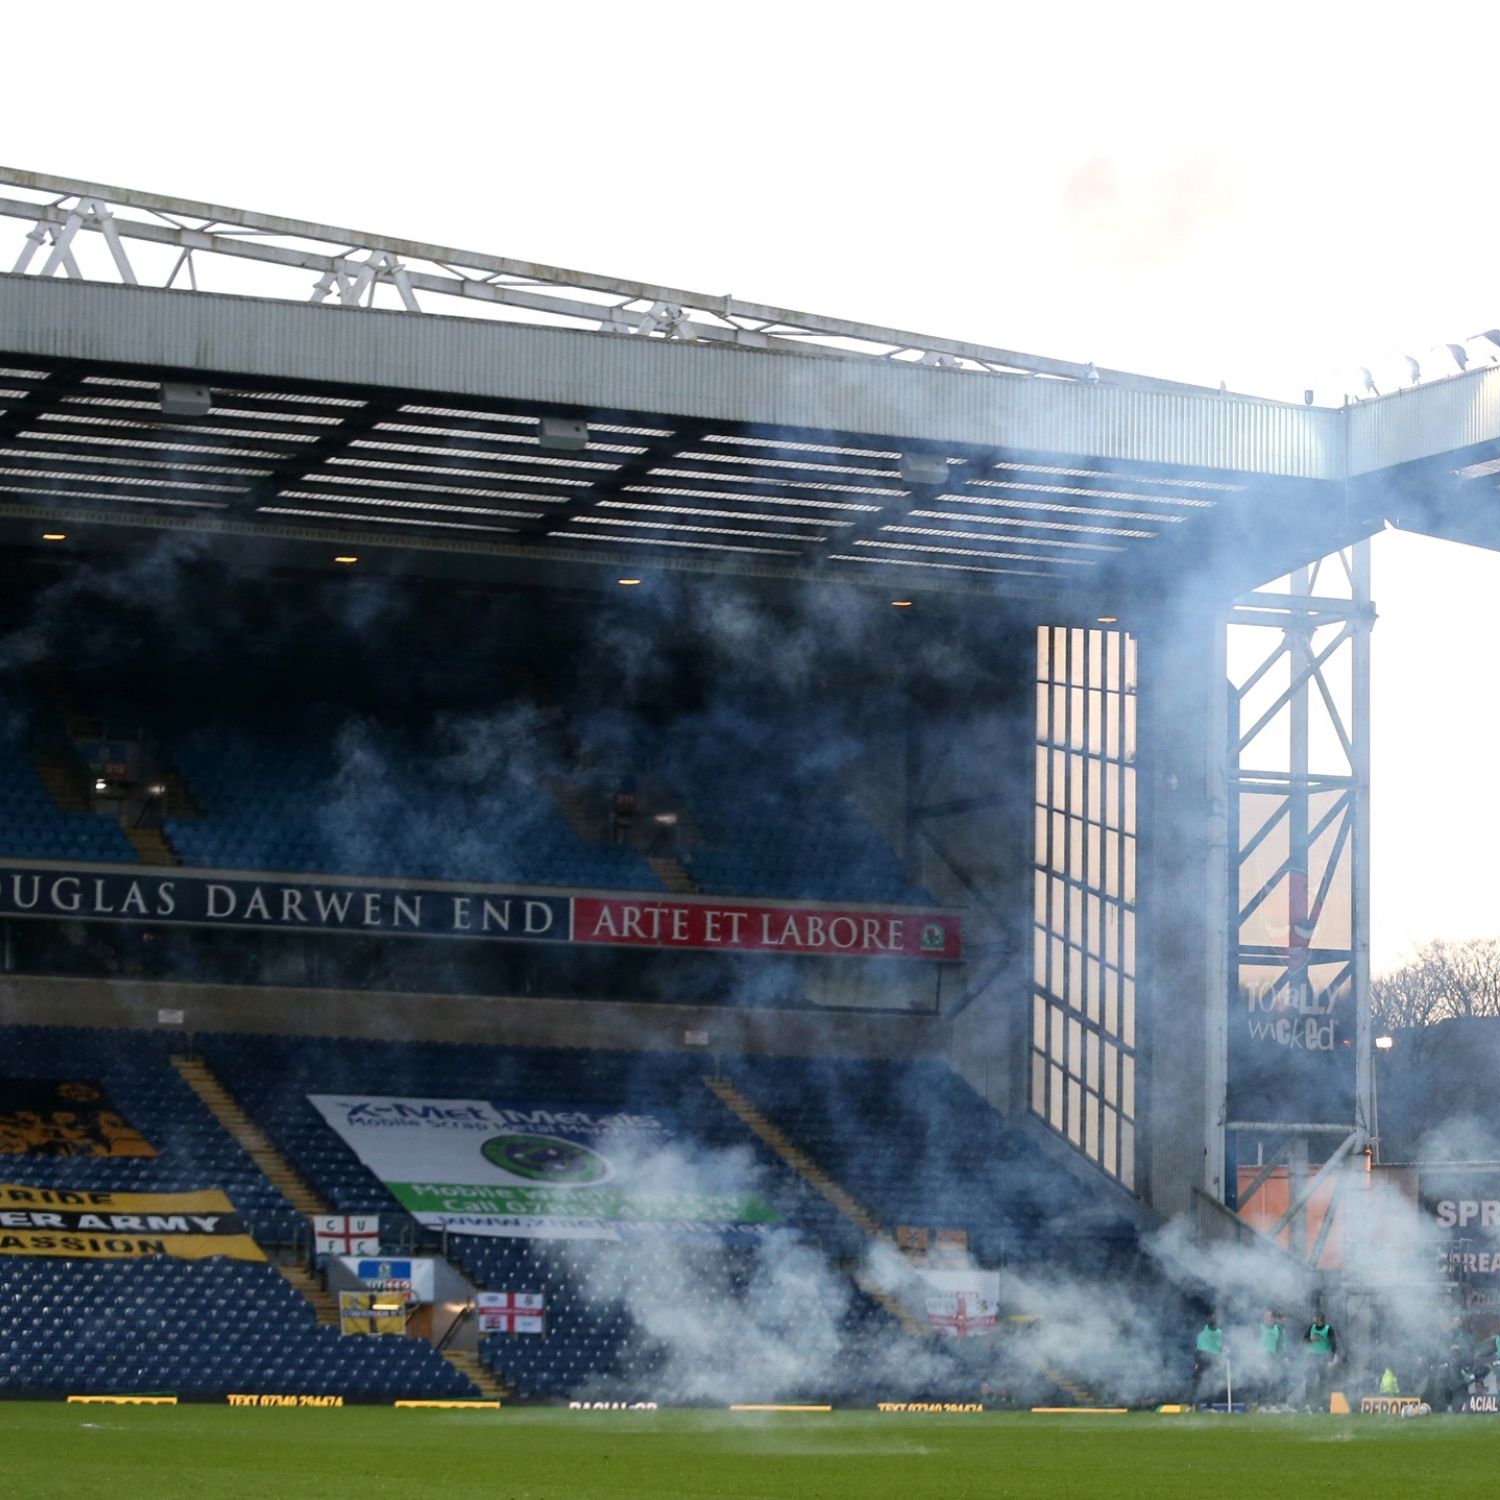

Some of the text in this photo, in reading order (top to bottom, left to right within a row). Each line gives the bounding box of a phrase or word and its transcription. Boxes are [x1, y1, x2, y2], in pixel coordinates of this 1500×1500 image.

[0, 874, 556, 933] UGLAS DARWEN END
[592, 905, 904, 951] ARTE ET LABORE
[0, 1190, 113, 1204] RIDE
[78, 1214, 219, 1232] ARMY
